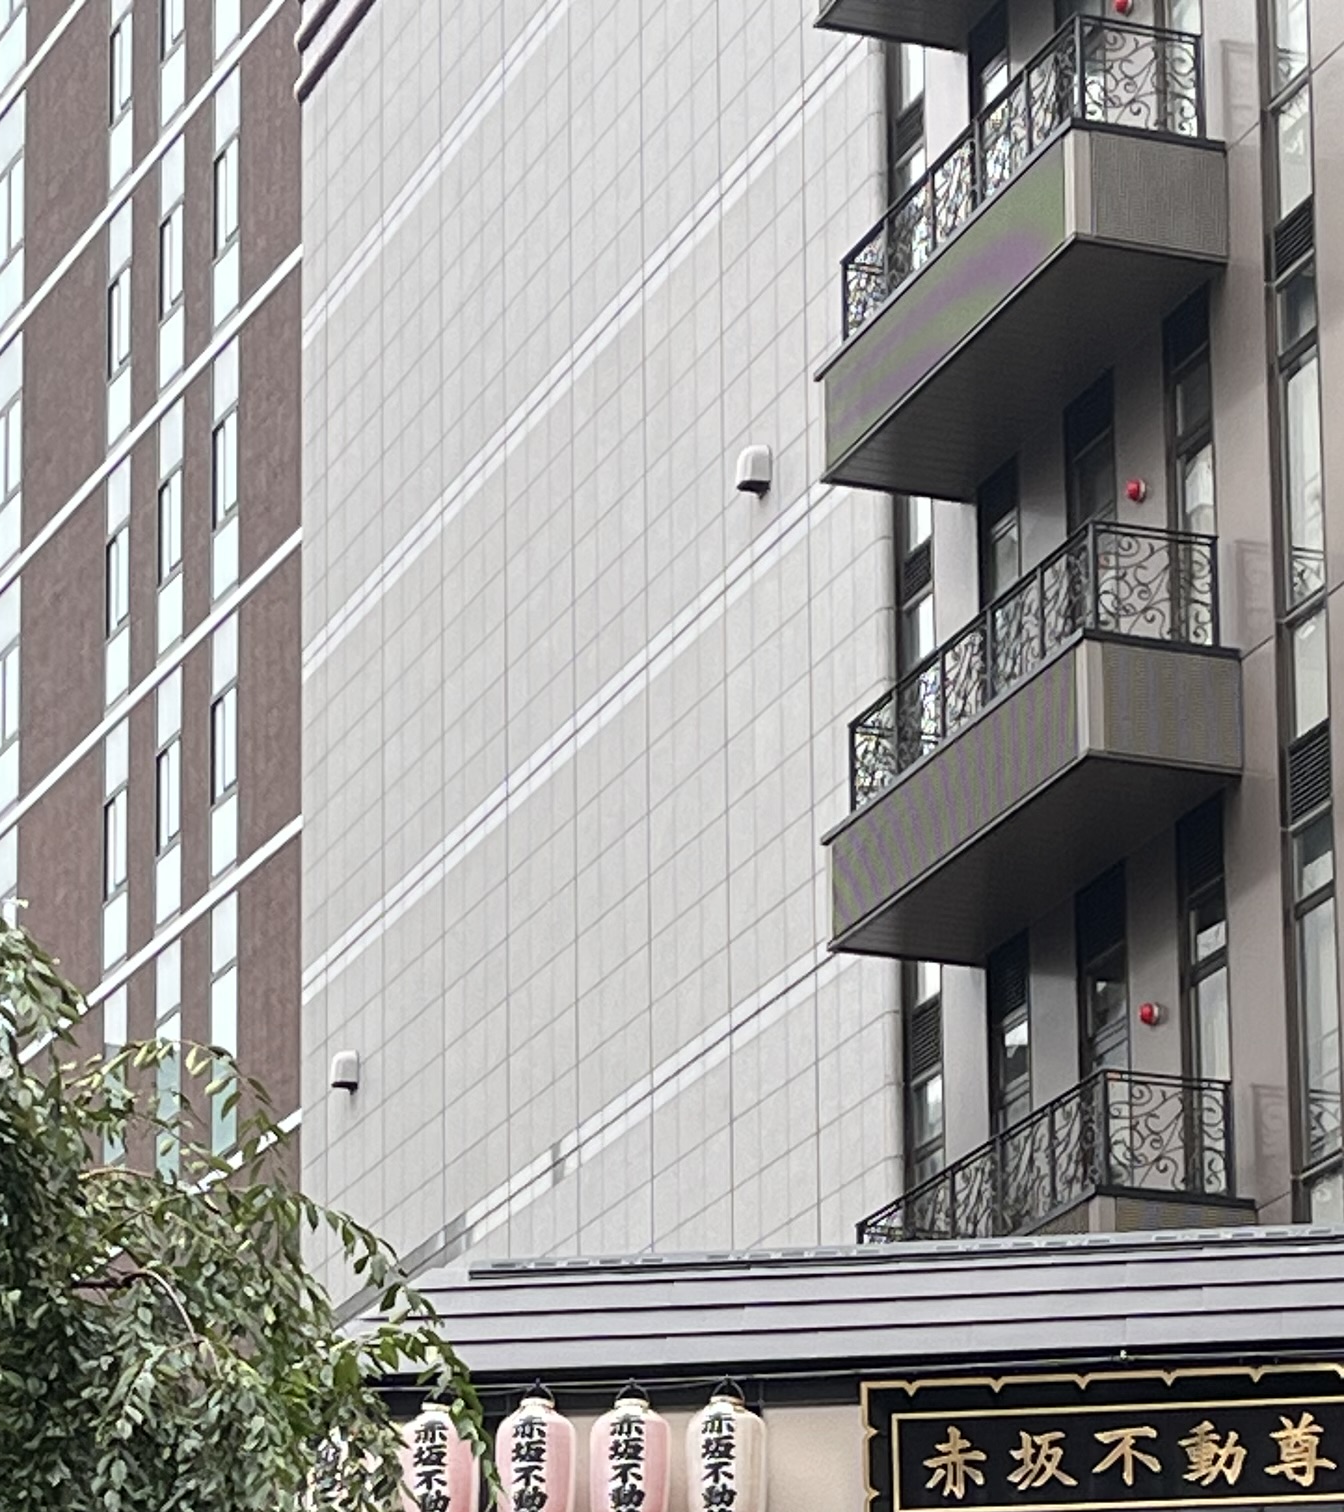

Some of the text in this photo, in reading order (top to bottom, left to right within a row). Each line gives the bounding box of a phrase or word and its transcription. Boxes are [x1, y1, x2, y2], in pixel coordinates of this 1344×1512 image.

[922, 1411, 1337, 1499] 赤坂不動尊
